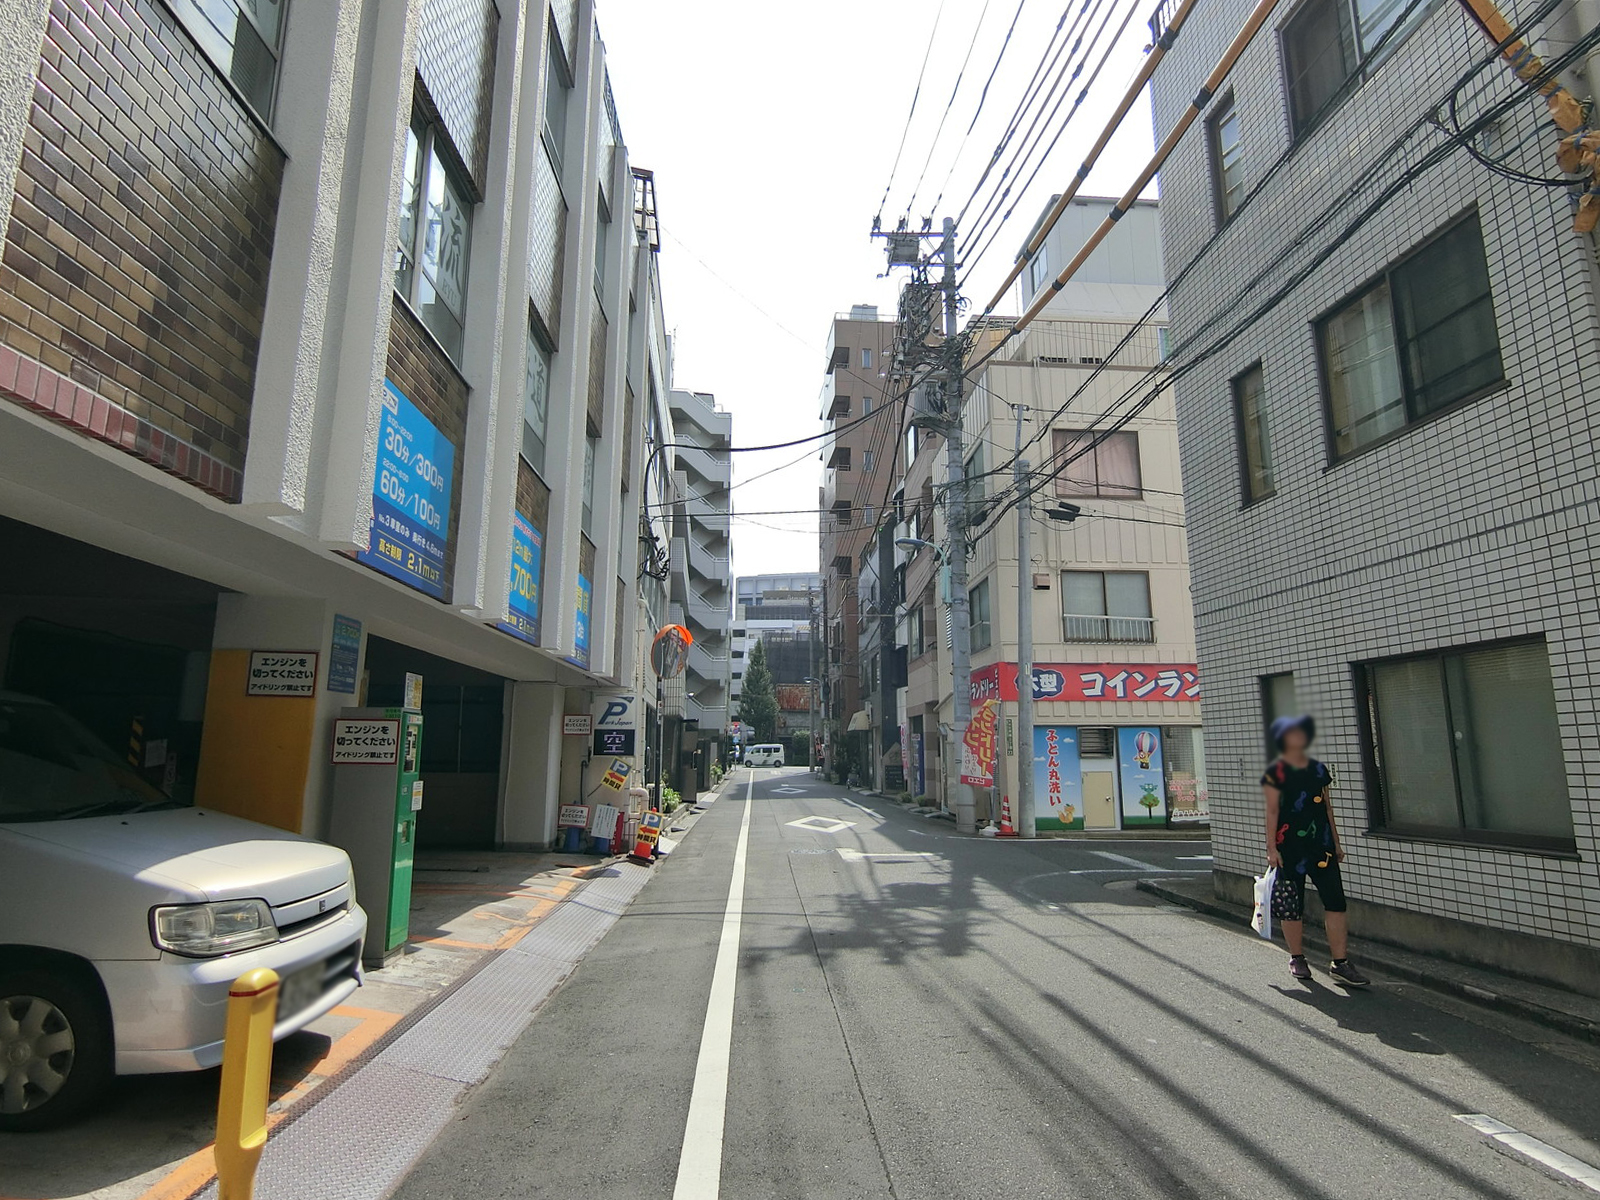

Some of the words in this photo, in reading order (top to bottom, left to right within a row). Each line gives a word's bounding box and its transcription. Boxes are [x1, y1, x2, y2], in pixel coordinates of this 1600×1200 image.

[385, 426, 444, 493] 30分/300円
[380, 469, 441, 531] 60分/100円
[261, 657, 307, 668] エンジンを
[252, 668, 314, 679] 切ってください
[250, 683, 313, 692] アイドリング禁止です
[1079, 670, 1200, 698] コインラン
[345, 725, 389, 735] エンジンを
[336, 736, 396, 747] 切ってください
[603, 731, 626, 753] 空
[335, 751, 395, 759] アイドリング禁止です
[612, 761, 628, 775] P
[1046, 729, 1062, 807] ふとん丸洗い
[643, 813, 659, 825] P
